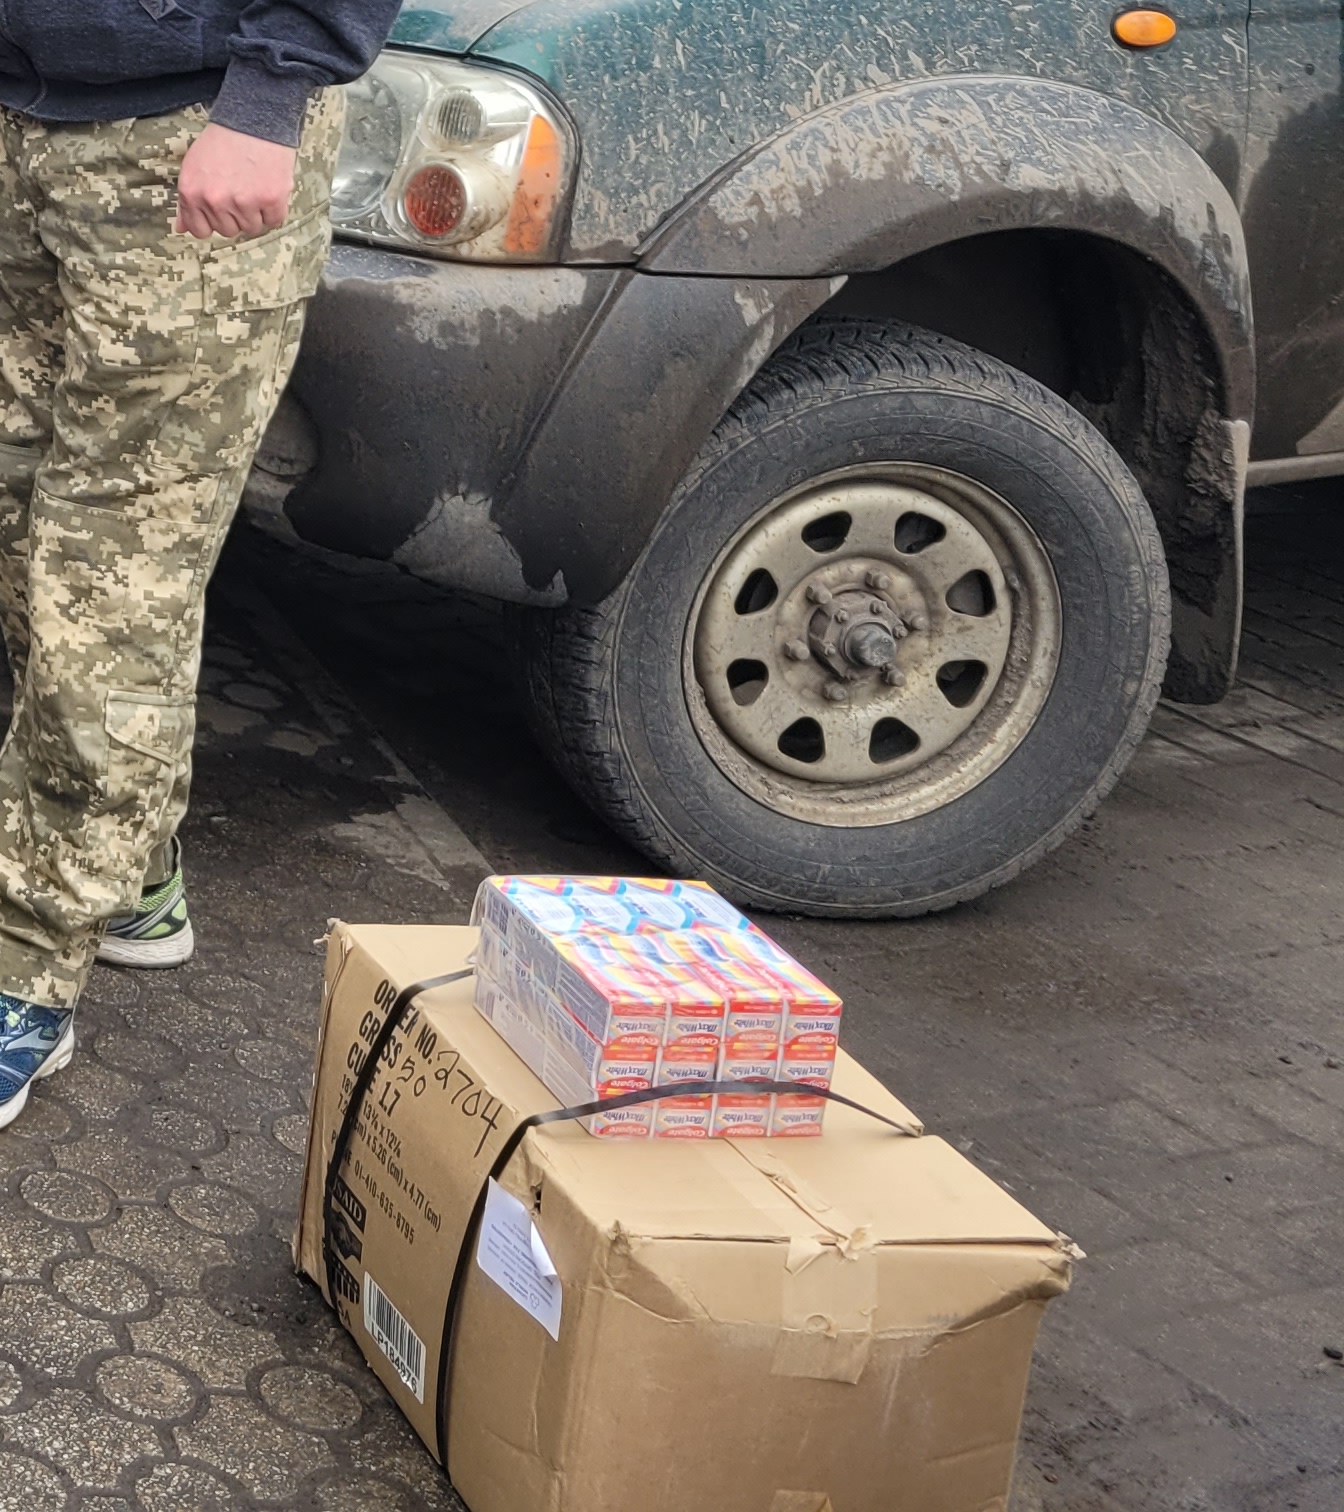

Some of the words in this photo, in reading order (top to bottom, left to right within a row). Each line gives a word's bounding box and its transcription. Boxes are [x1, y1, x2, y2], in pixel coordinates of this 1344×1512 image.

[374, 979, 420, 1039] ORER
[414, 1023, 438, 1065] NO.
[621, 1035, 660, 1046] Colgate
[681, 1037, 719, 1046] Colgate
[739, 1032, 777, 1042] Colgate
[798, 1035, 835, 1045] Colgate
[359, 1010, 403, 1069] GRSS
[396, 1055, 426, 1097] 50
[347, 1042, 382, 1096] CUE
[378, 1081, 401, 1118] 1.7
[611, 1080, 649, 1090] Colgate
[608, 1126, 648, 1135] Colgate
[667, 1128, 705, 1137] Colgate
[726, 1126, 764, 1136] Colgate
[372, 1136, 387, 1165] 5.26
[387, 1156, 403, 1187] (cm)
[409, 1183, 424, 1210] 4.77
[424, 1201, 441, 1232] (cm)
